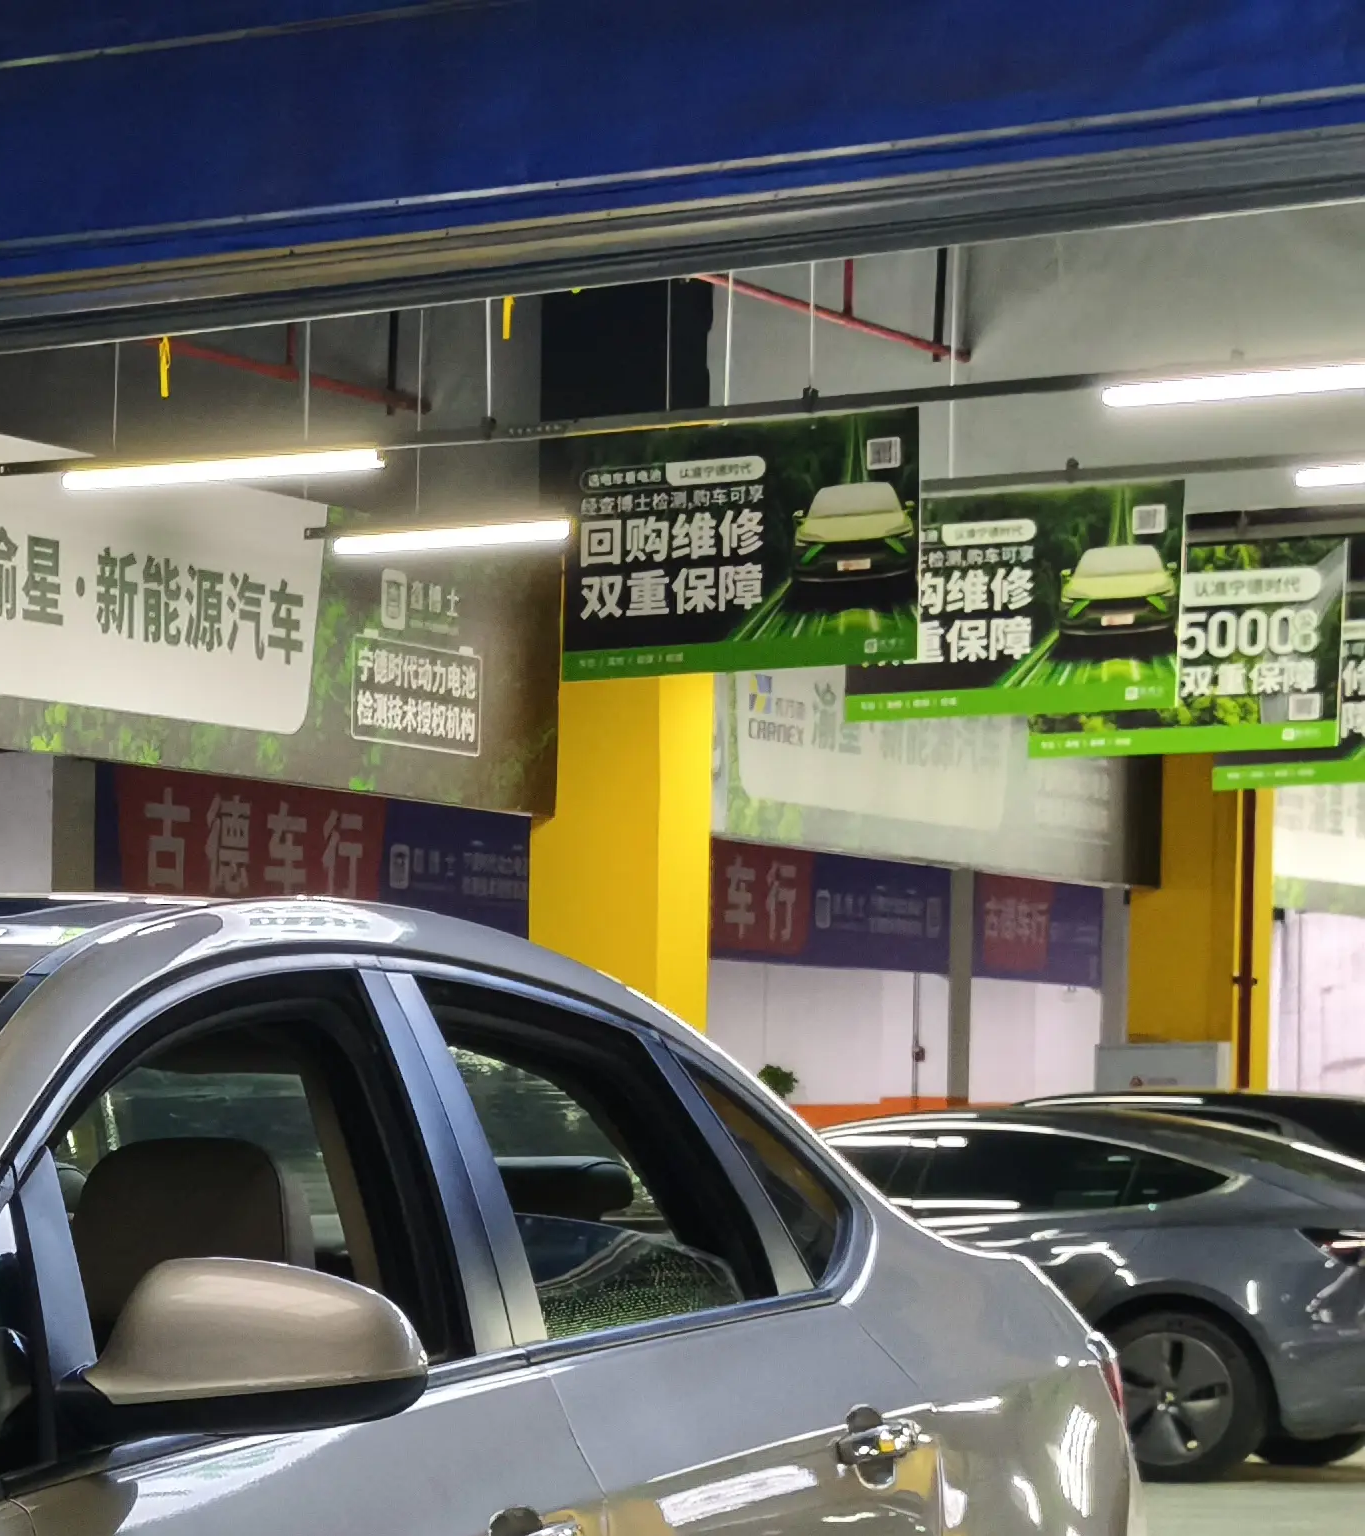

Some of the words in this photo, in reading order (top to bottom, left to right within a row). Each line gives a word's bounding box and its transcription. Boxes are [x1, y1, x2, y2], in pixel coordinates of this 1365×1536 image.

[580, 508, 765, 567] 回购维修
[580, 562, 764, 620] 双重保障
[1180, 656, 1317, 698] 双重保障
[144, 787, 364, 897] 古德车行
[724, 855, 798, 942] 车行
